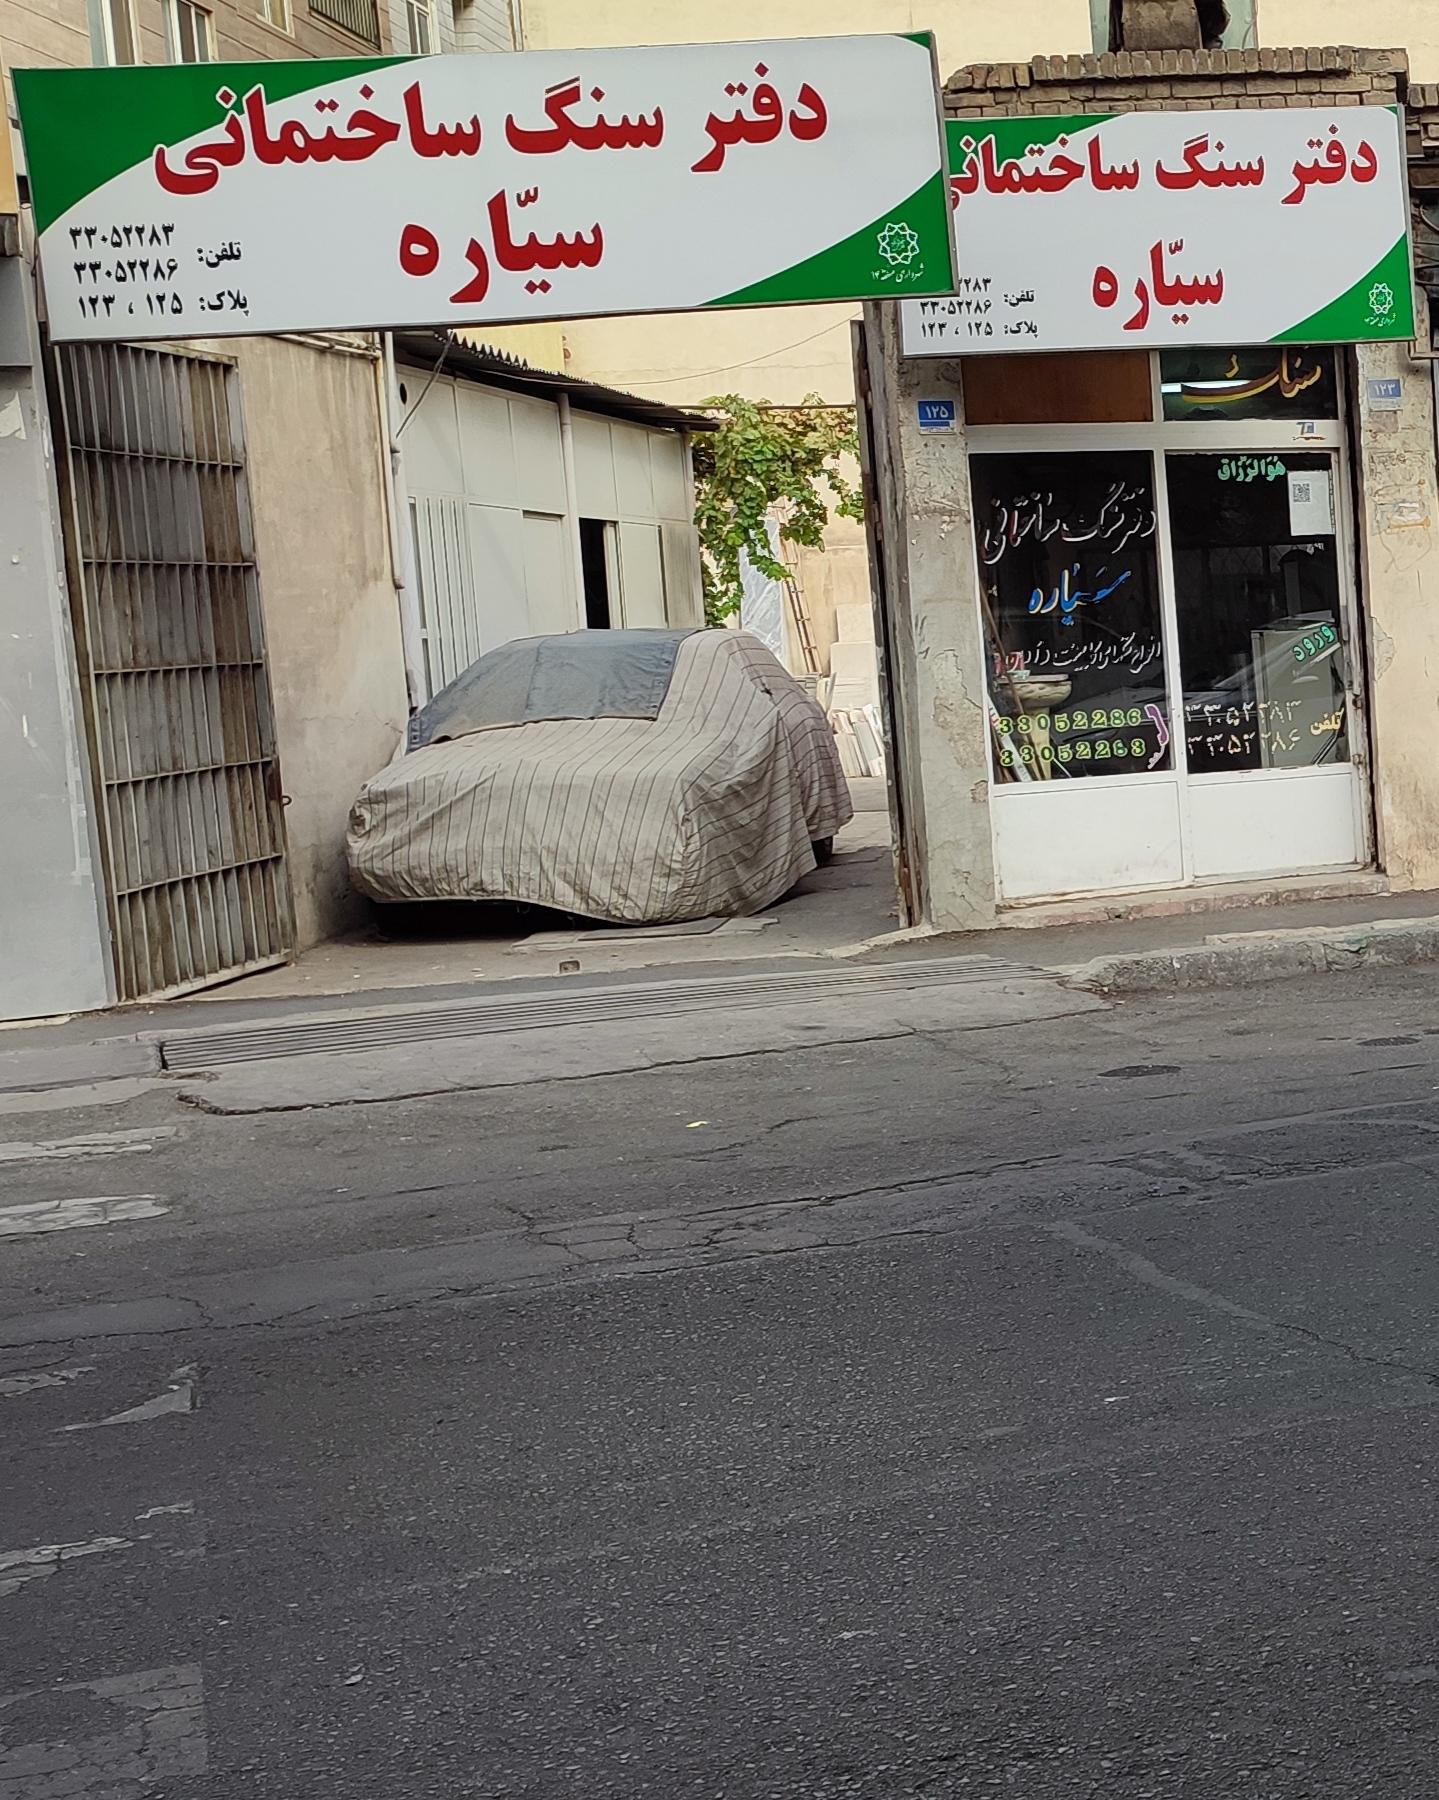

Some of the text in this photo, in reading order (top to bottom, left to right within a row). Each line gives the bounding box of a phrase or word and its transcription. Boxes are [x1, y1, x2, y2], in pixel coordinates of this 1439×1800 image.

[154, 61, 828, 195] دفتر سنگ ساختمانی
[950, 123, 1378, 210] دفتر سنگ ساختمان
[68, 222, 175, 250] ۳۳۰۵۲۲۸۳
[196, 241, 242, 268] تلفن:
[73, 258, 178, 284] ۳۳۰۵۲۲۸۶
[78, 294, 116, 318] ۱۲۳
[146, 292, 183, 315] ۱۲۵
[199, 289, 250, 317] پلاک:
[920, 299, 992, 316] ۳۳۰۵۲۲۸۶
[1003, 289, 1035, 307] تلفن:
[920, 322, 947, 338] ۱۲۳
[967, 321, 993, 337] ۱۲۵
[1004, 320, 1038, 338] پلاک:
[1374, 383, 1396, 396] ۱۲۳
[925, 405, 949, 419] ۱۲۵
[1292, 623, 1336, 662] ورود
[999, 707, 1142, 736] 33052286
[1309, 707, 1345, 736] تلفن
